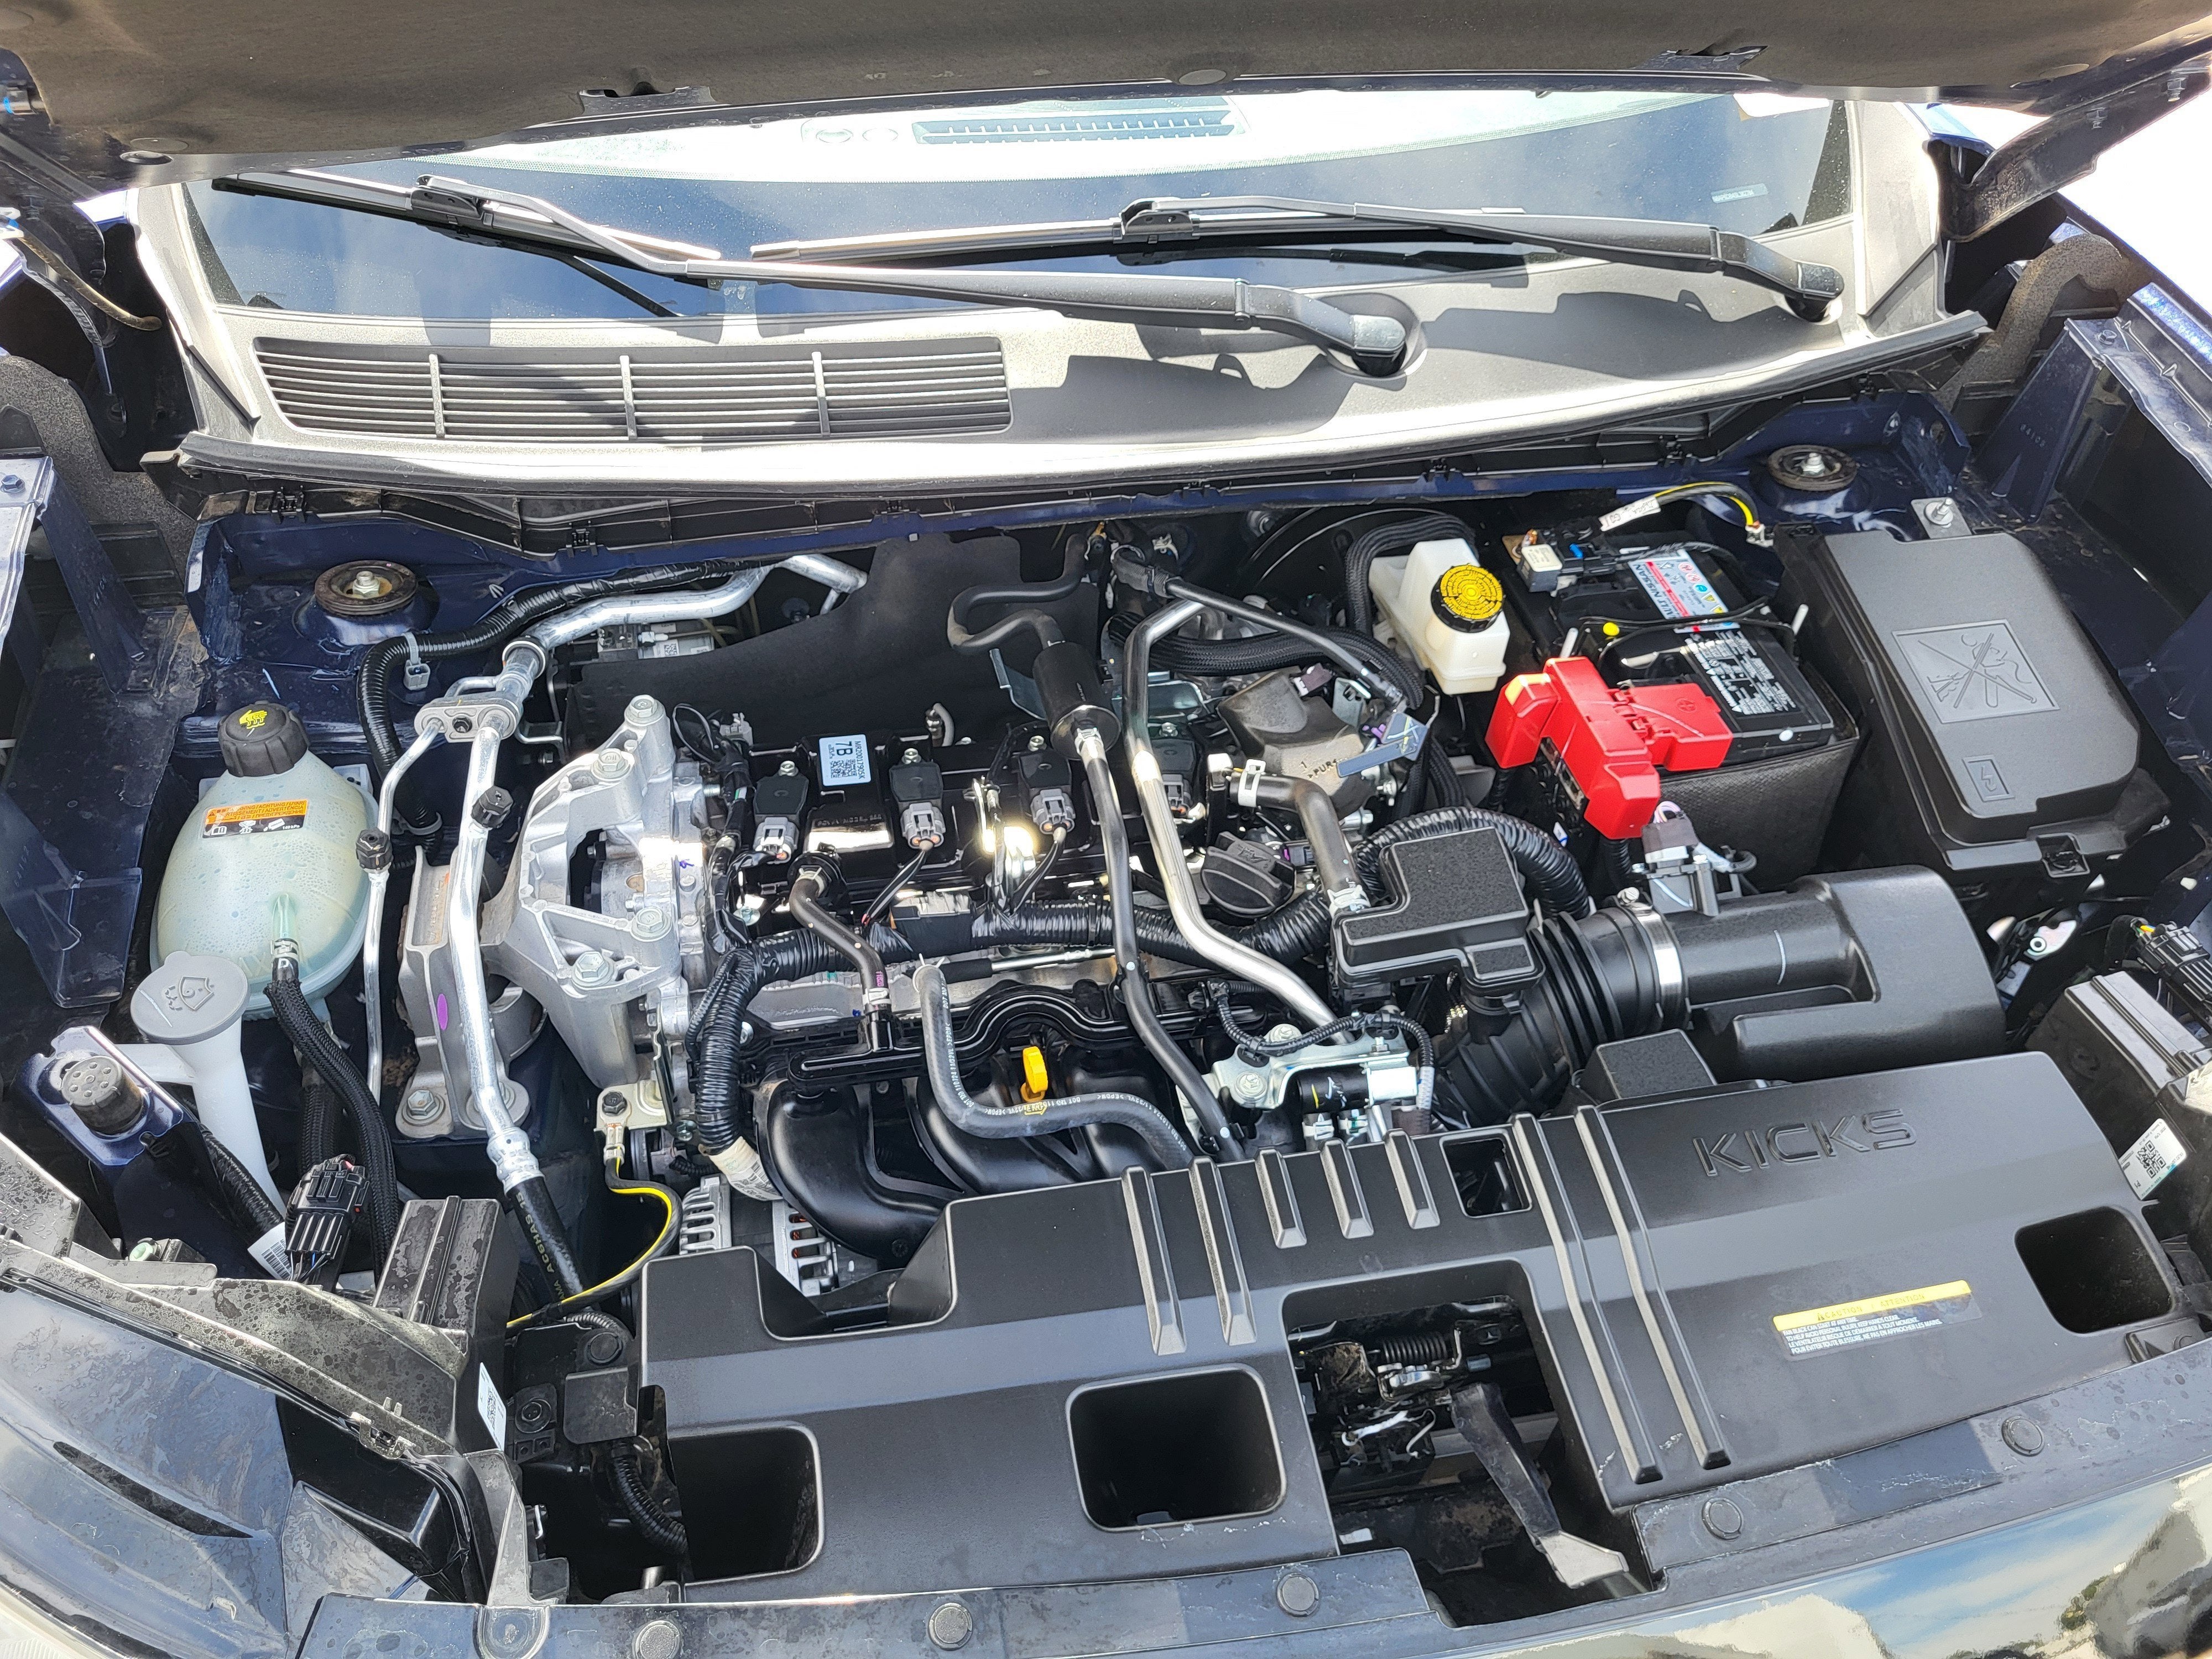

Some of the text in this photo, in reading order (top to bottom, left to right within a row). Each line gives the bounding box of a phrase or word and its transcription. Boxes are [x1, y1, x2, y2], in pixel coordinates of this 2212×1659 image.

[1632, 563, 1663, 598] NISSAN
[836, 741, 853, 755] 7B
[1692, 1108, 1917, 1177] KICKS
[1824, 1306, 1863, 1318] CAUTION
[1879, 1292, 1925, 1307] ATTENTION
